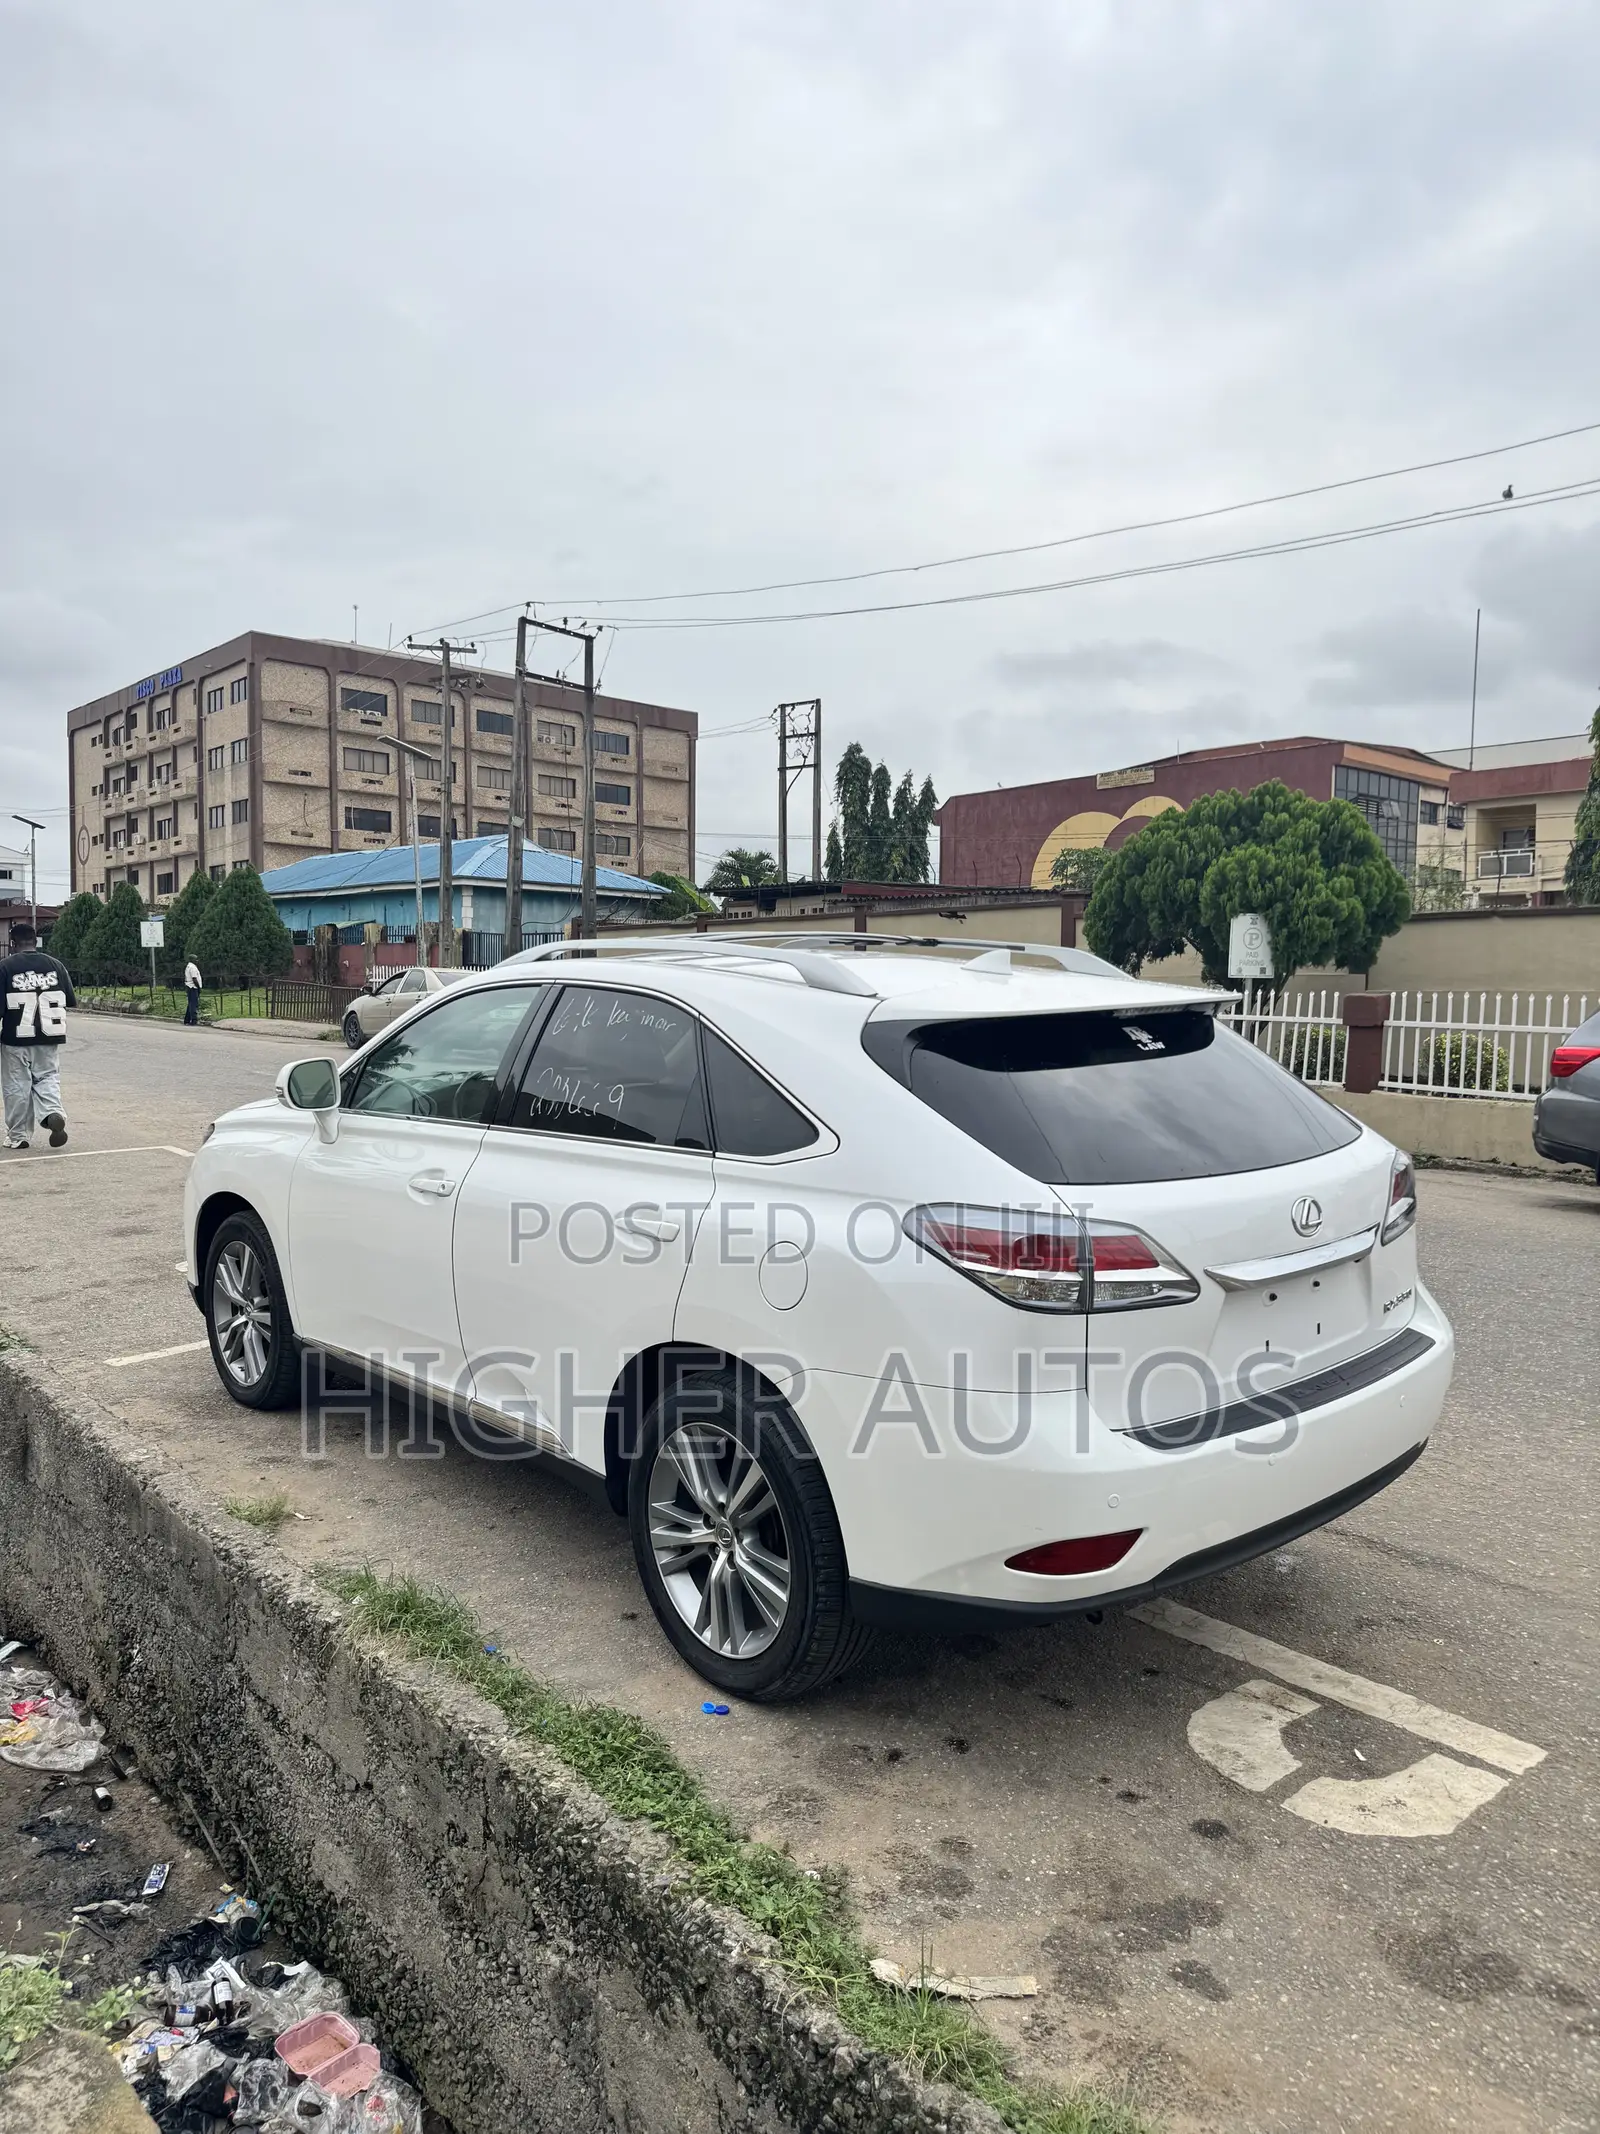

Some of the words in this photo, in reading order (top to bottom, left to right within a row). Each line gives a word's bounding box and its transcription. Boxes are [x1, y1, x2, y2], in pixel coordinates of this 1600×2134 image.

[160, 665, 182, 690] PLAZA
[1247, 932, 1260, 946] P
[1246, 951, 1259, 959] PAID
[6, 990, 67, 1038] 76
